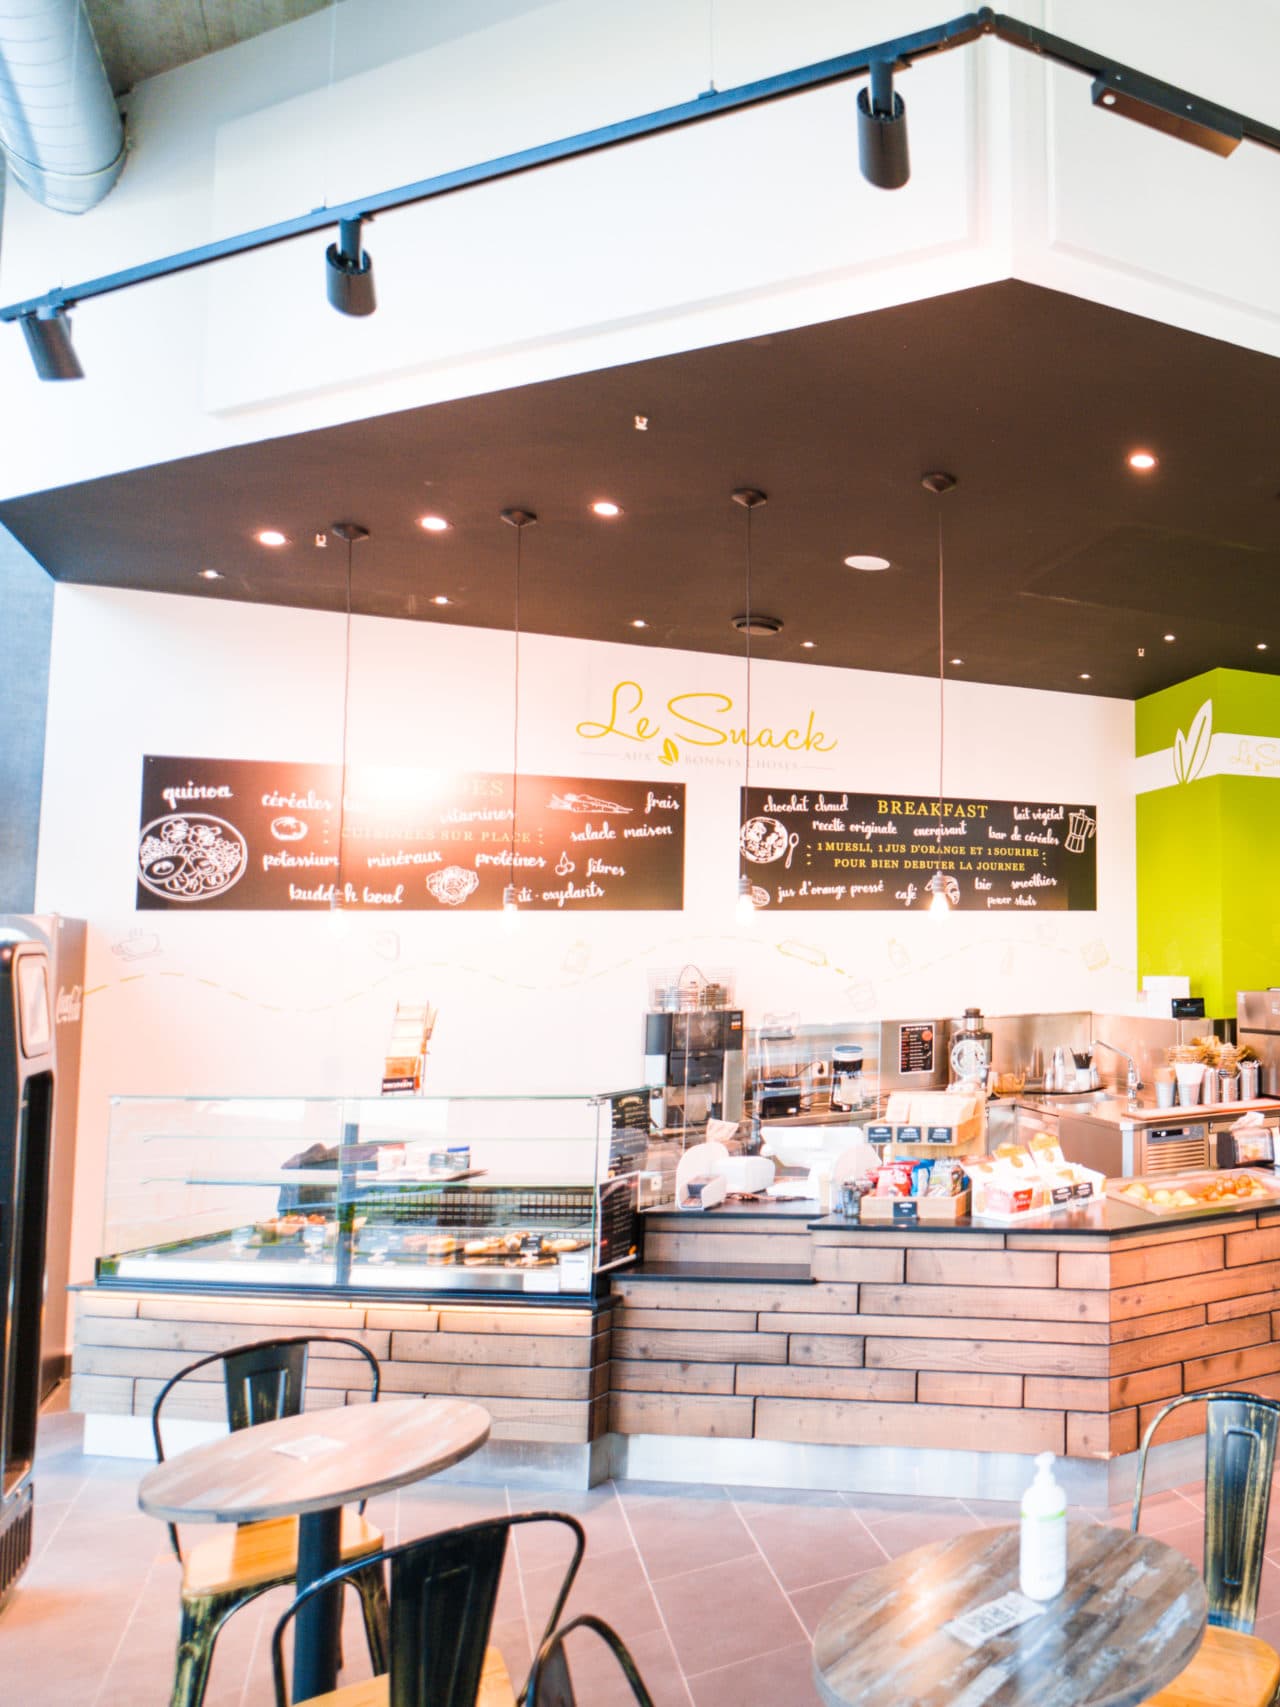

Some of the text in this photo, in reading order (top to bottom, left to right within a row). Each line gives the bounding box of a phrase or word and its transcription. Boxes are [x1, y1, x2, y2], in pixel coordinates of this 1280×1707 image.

[576, 680, 838, 752] Le Snack
[162, 780, 234, 810] quinoa
[261, 791, 333, 811] céréales
[645, 791, 680, 814] frais
[763, 793, 848, 813] chocolat chaud
[439, 808, 514, 824] vitamines
[877, 800, 989, 819] BREAKFAST
[1013, 806, 1064, 826] lait végétal
[440, 831, 473, 841] SUR
[481, 831, 530, 842] PLACE
[570, 821, 672, 842] salade maison
[812, 817, 898, 840] recette originale
[913, 820, 968, 843] energisant
[988, 826, 1060, 846] bar de céréales
[825, 842, 873, 853] MUESLI,
[885, 844, 906, 854] JUS
[911, 845, 966, 855] D'ORANGE
[970, 847, 984, 856] ET
[993, 847, 1039, 857] SOURIRE
[263, 850, 626, 877] potassium minéraux protéines fibres
[834, 858, 1026, 872] POUR BIEN DEBUTER LA JOURNEE
[777, 880, 885, 903] jus d'orange pressé
[974, 877, 993, 891] bio
[1010, 873, 1058, 890] smoothies
[362, 884, 404, 904] bowl
[895, 883, 918, 906] café
[986, 896, 1012, 908] power
